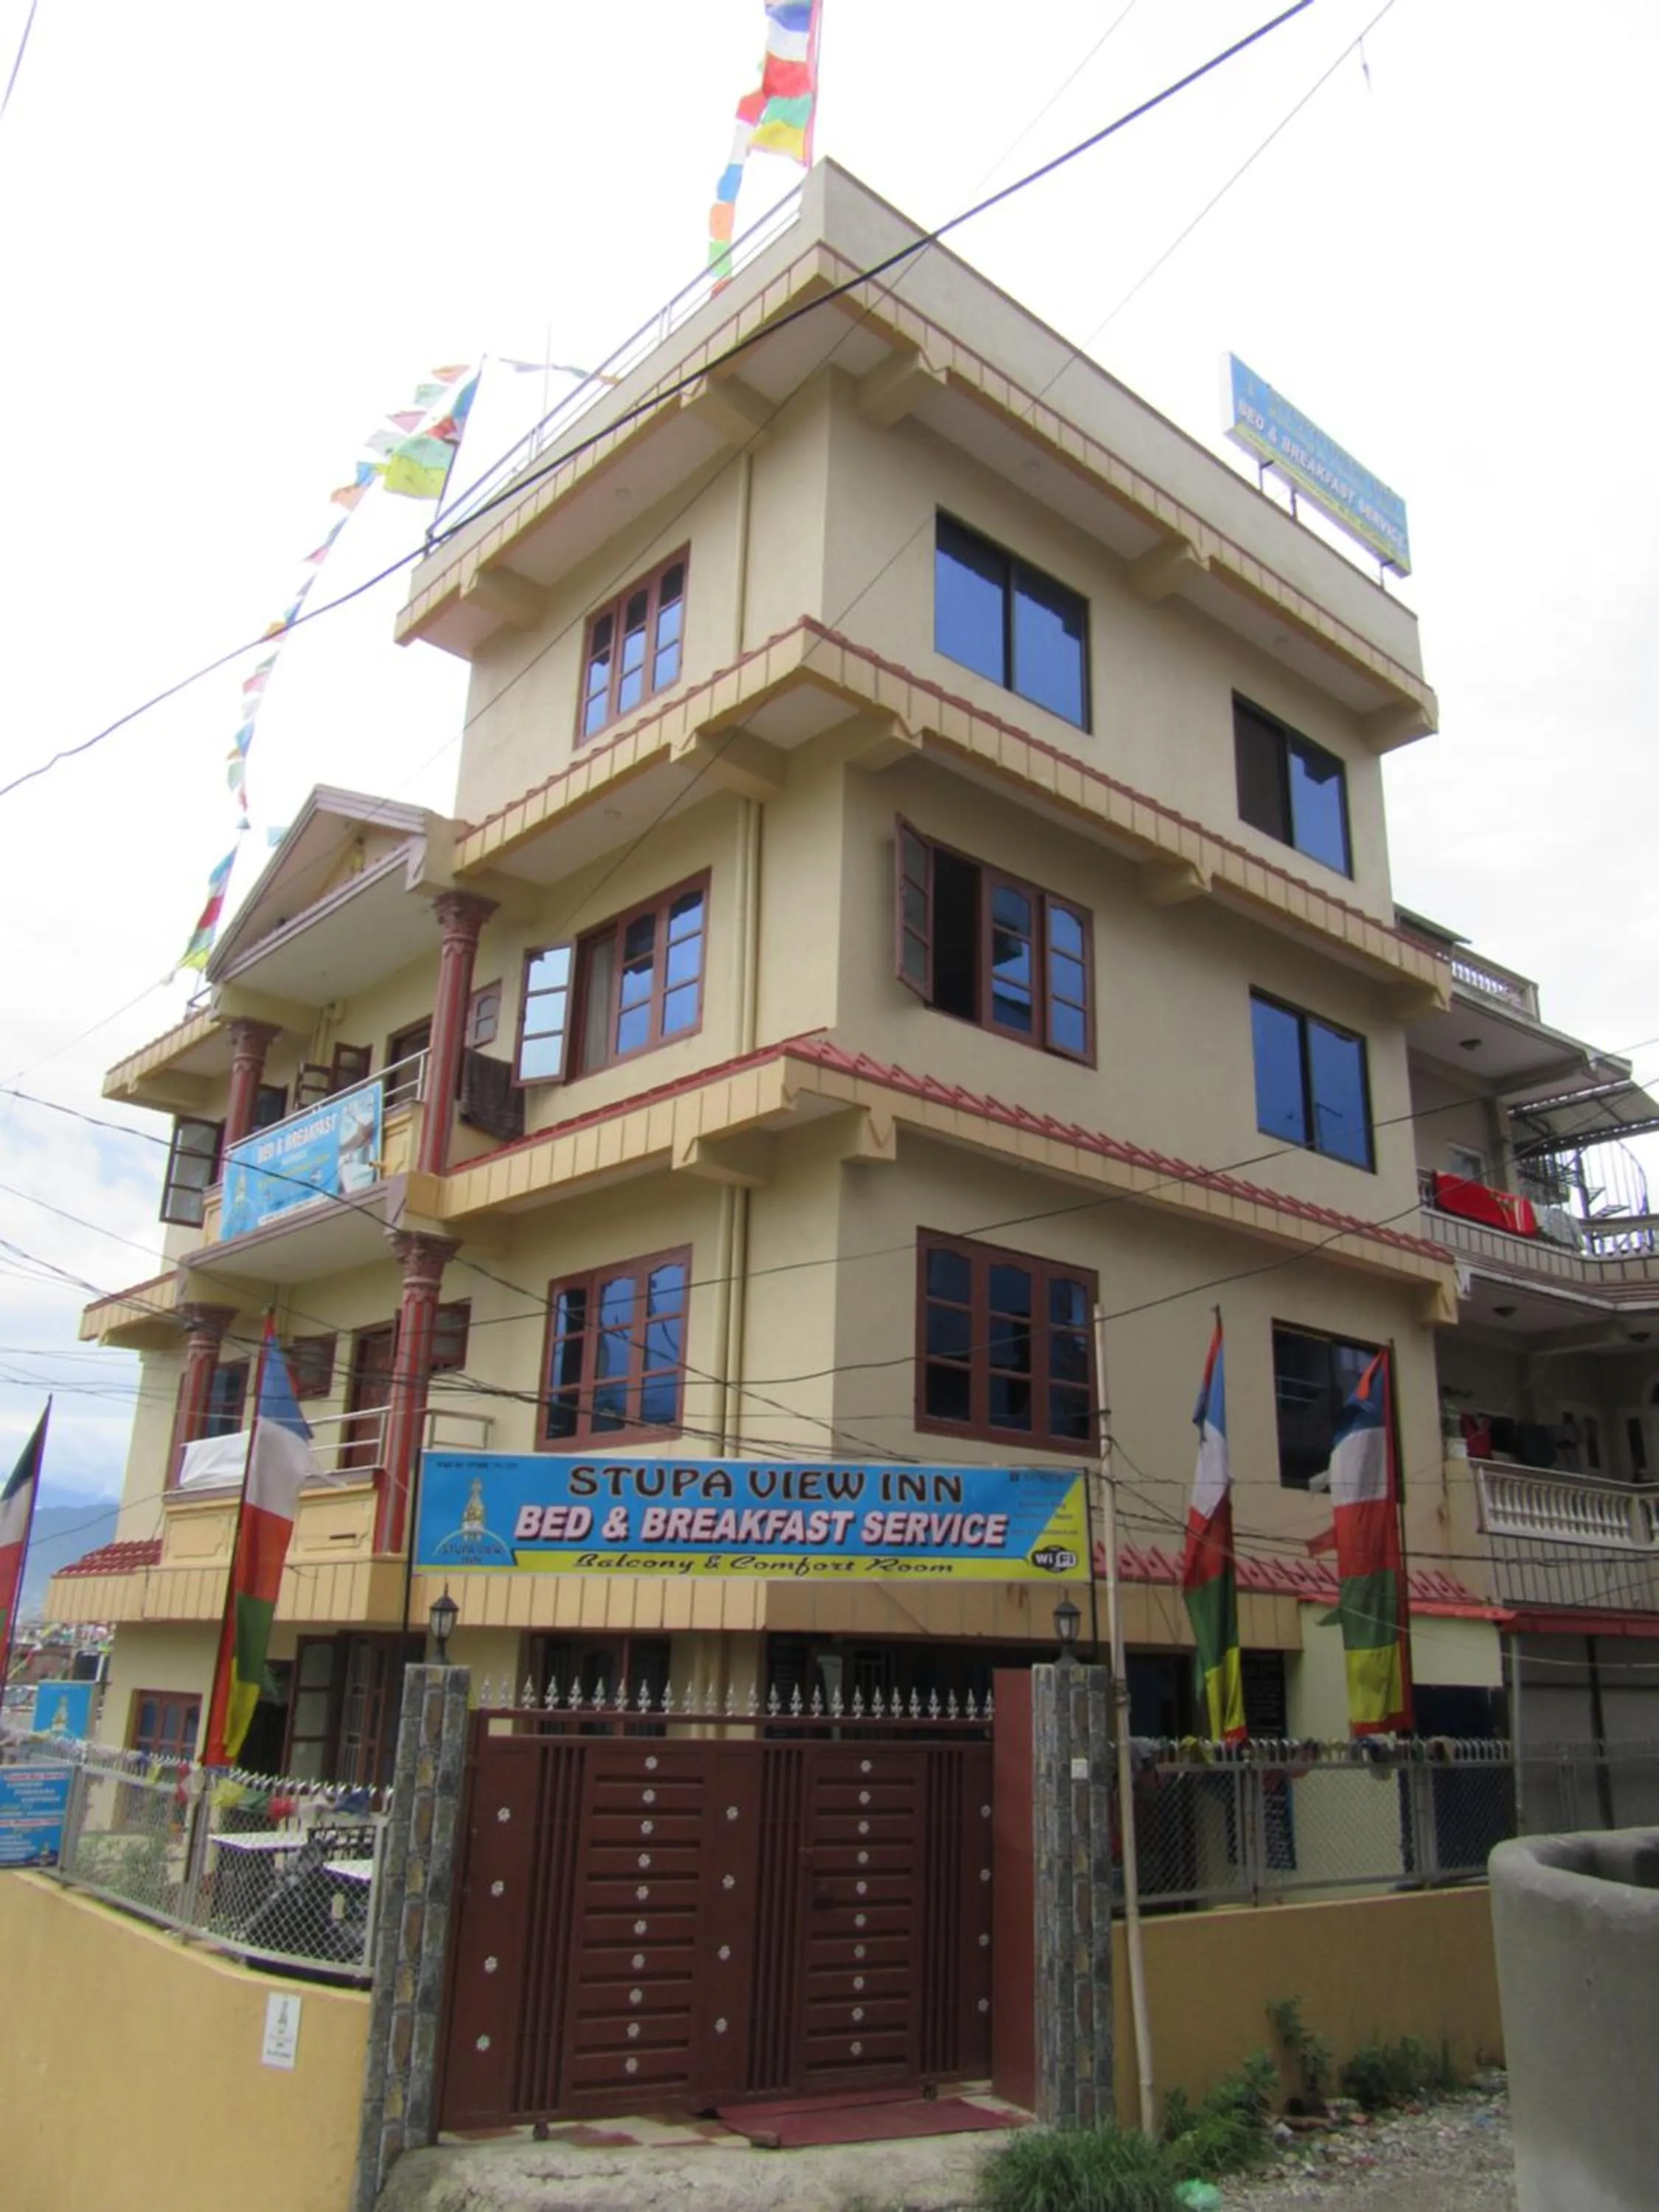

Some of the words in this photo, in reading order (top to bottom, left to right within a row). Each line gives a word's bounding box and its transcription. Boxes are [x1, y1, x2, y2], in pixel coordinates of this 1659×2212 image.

[568, 1465, 734, 1499] STUPA
[748, 1469, 866, 1502] VIEW
[880, 1472, 963, 1503] INN
[514, 1504, 594, 1540] BED
[601, 1505, 629, 1540] &
[640, 1506, 856, 1545] BREAKFAST
[861, 1511, 1009, 1547] SERVICE
[574, 1553, 694, 1574] Balcony
[704, 1554, 720, 1570] &
[730, 1554, 855, 1576] Comfort
[865, 1557, 953, 1573] Room
